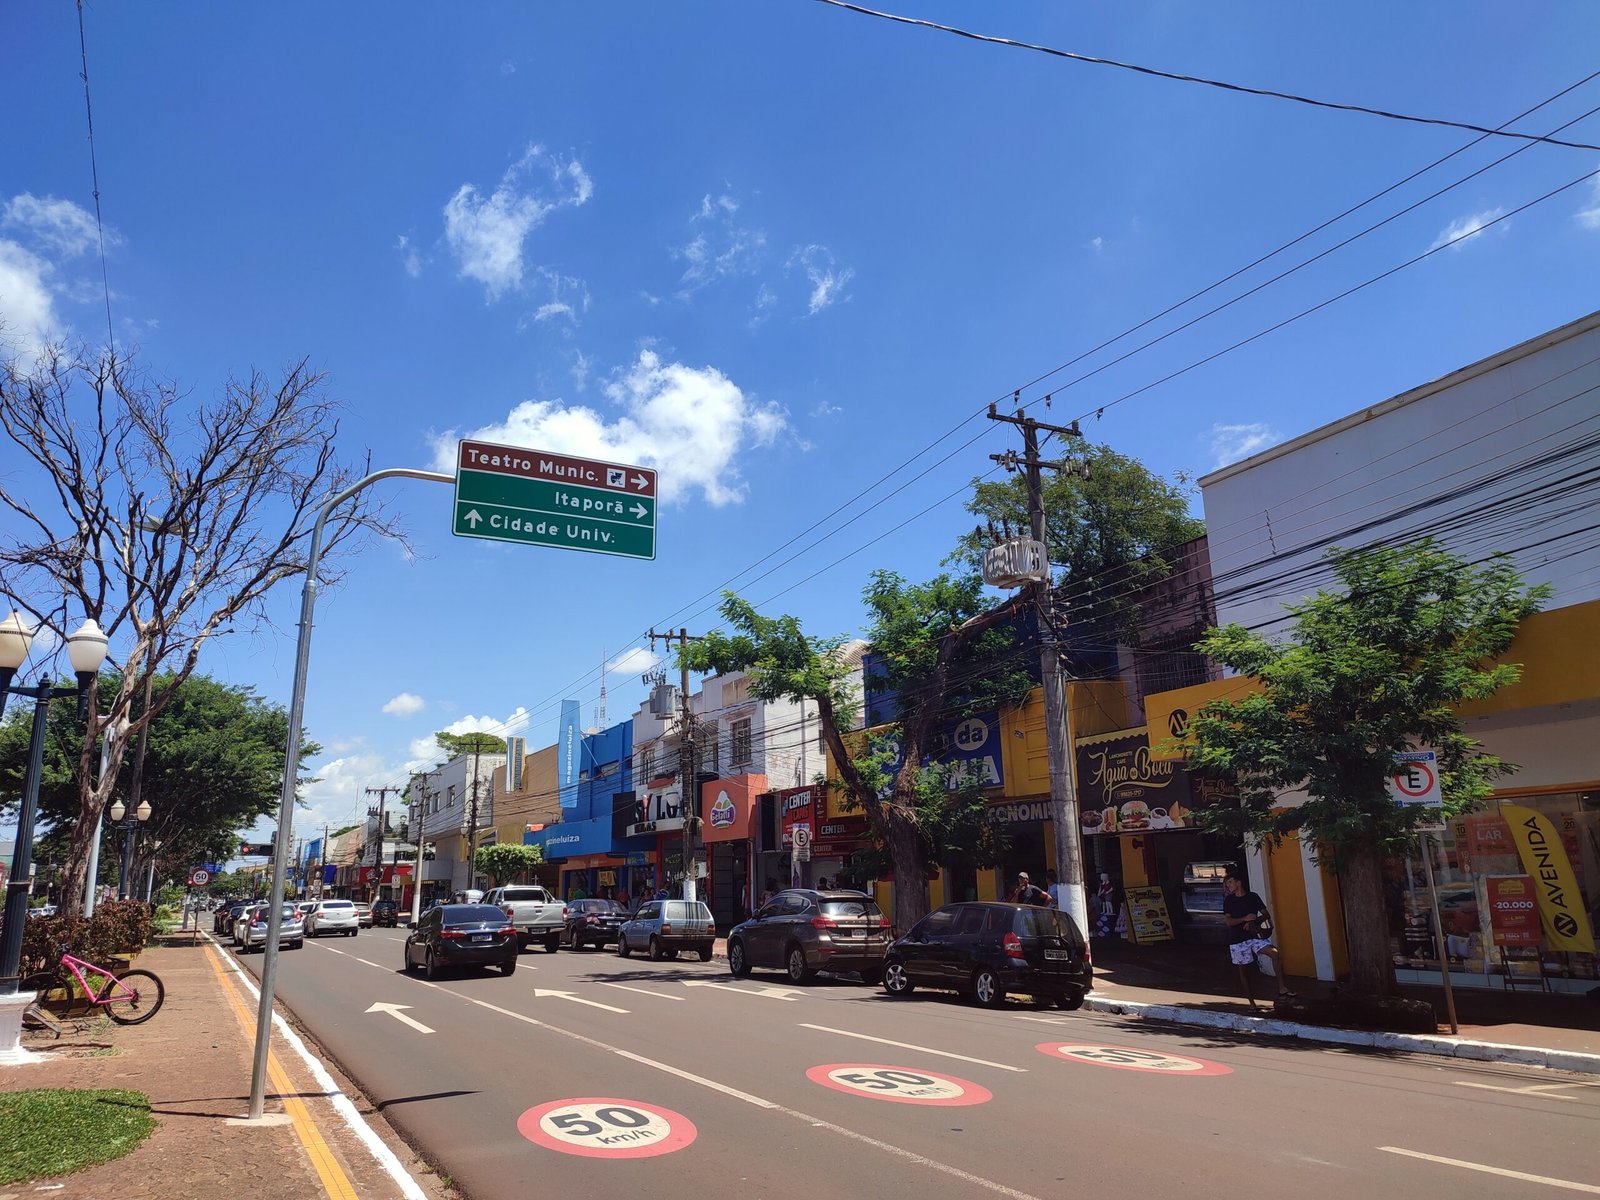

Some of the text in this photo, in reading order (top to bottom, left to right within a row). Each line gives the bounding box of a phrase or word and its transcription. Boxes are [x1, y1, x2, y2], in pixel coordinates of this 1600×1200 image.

[468, 449, 599, 481] Teatro Munic.
[554, 491, 624, 514] Itaporã
[489, 514, 615, 543] Cidade Univ.
[957, 723, 984, 744] da
[1408, 771, 1421, 788] E
[789, 790, 811, 809] CENTER
[1476, 830, 1502, 841] LAR
[1523, 816, 1568, 909] AVENIDA
[1068, 1049, 1167, 1063] 50
[836, 1070, 935, 1090] 50
[549, 1107, 650, 1136] 50
[596, 1129, 657, 1145] km/h
